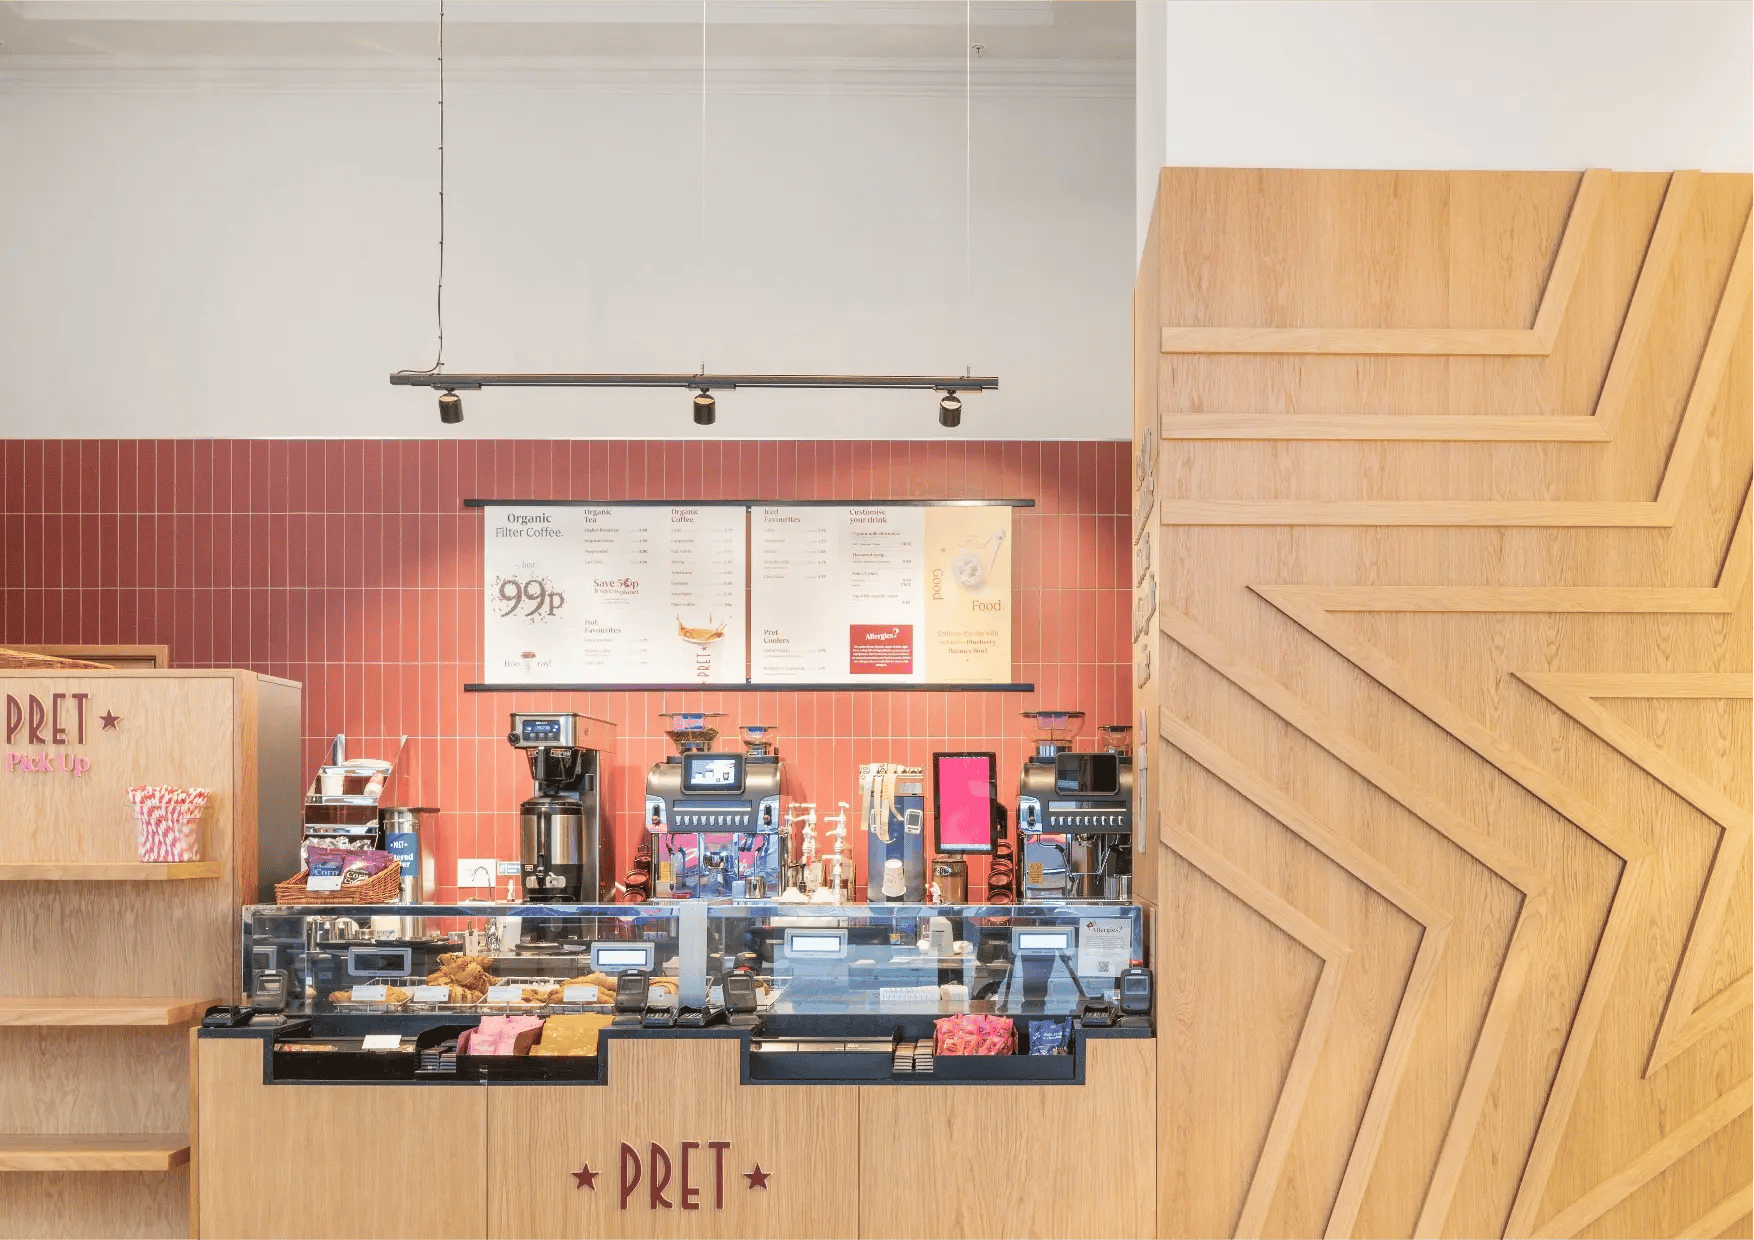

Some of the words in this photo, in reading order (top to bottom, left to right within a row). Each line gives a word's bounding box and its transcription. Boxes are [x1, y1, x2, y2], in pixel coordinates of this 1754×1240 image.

[585, 508, 612, 516] Organic
[671, 508, 699, 516] Organic
[849, 508, 886, 516] Customise
[507, 512, 552, 525] Organic
[849, 517, 866, 525] your
[495, 527, 524, 537] Filter
[526, 527, 564, 537] Coffee.
[521, 561, 536, 569] Just
[593, 578, 615, 588] Save
[933, 568, 944, 600] Good
[498, 579, 565, 617] 99p
[972, 600, 1005, 611] Food.
[865, 627, 900, 641] Allergies?
[966, 639, 997, 647] Blueberry
[696, 652, 711, 677] PRET
[6, 692, 91, 745] PRET
[6, 751, 54, 773] Pick
[58, 752, 91, 777] Up
[393, 852, 414, 861] tered
[314, 868, 338, 876] Corn
[620, 1141, 731, 1210] PRET
